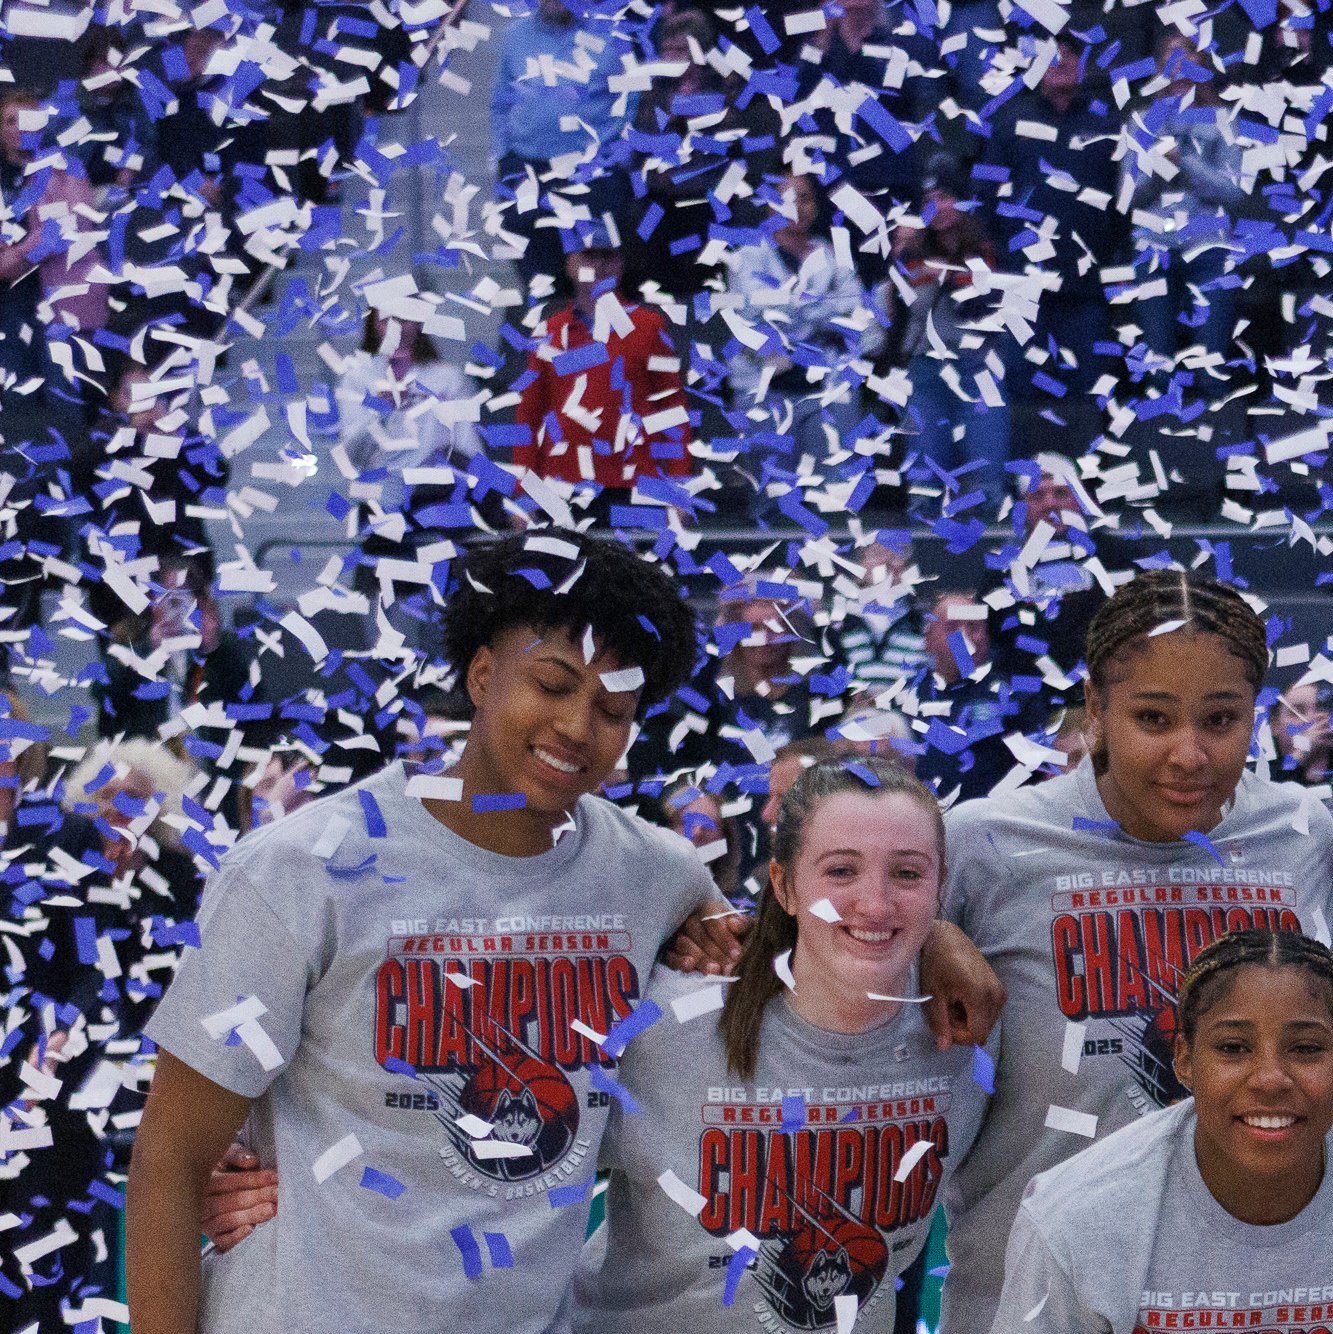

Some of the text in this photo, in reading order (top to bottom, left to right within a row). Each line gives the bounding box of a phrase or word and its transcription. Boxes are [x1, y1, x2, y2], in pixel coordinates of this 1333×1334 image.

[1056, 868, 1295, 891] BIG EAST CONFERENCE
[1071, 885, 1282, 907] REGULAR SEASON
[391, 914, 626, 934] BIG EAST CONFERENCE
[402, 934, 609, 952] REGULAR SEASON
[1081, 1038, 1124, 1057] 025
[707, 1086, 747, 1102] BIG
[822, 1075, 950, 1102] CONFERENCE
[385, 1091, 440, 1111] 2025
[723, 1106, 838, 1123] REGAR
[699, 1115, 950, 1238] CHAMPIONS
[1181, 1291, 1240, 1308] EAST
[1148, 1310, 1263, 1328] REGULAR
